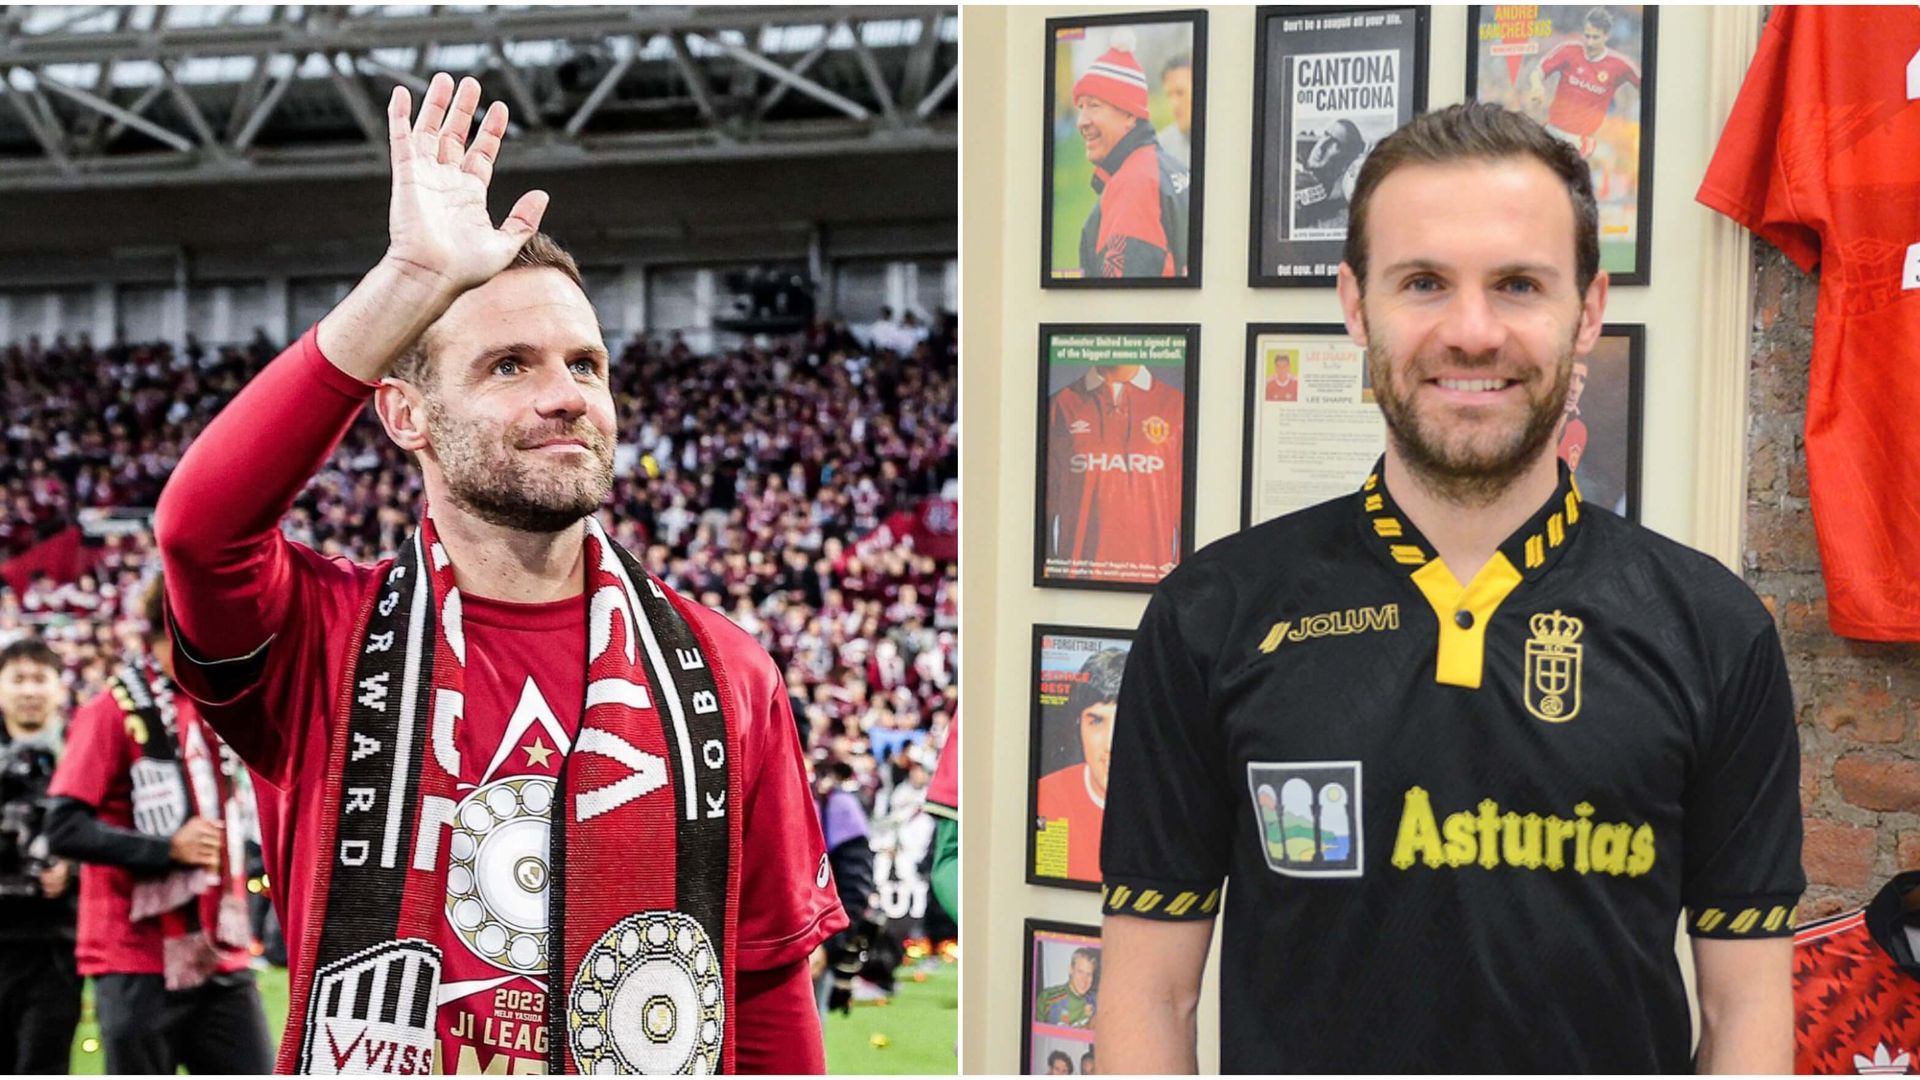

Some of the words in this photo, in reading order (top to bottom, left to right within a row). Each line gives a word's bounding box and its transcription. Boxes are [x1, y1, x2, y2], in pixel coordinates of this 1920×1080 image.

[1297, 55, 1395, 87] CANTONA
[1297, 90, 1314, 104] on
[1316, 85, 1395, 111] CANTONA
[1051, 336, 1095, 347] Manchester
[1096, 336, 1121, 347] United
[1123, 336, 1142, 347] have
[1145, 336, 1171, 349] signed
[1067, 349, 1080, 359] the
[1082, 349, 1111, 361] biggest
[1305, 396, 1321, 404] LEE
[1322, 396, 1353, 404] SHARPE
[1070, 452, 1165, 474] SHARP
[1041, 682, 1072, 696] BEST
[675, 647, 727, 819] KOBE
[1391, 785, 1656, 878] Asturias
[494, 988, 545, 1013] 2023
[450, 1010, 475, 1040] J1
[514, 1012, 543, 1023] YASUDA
